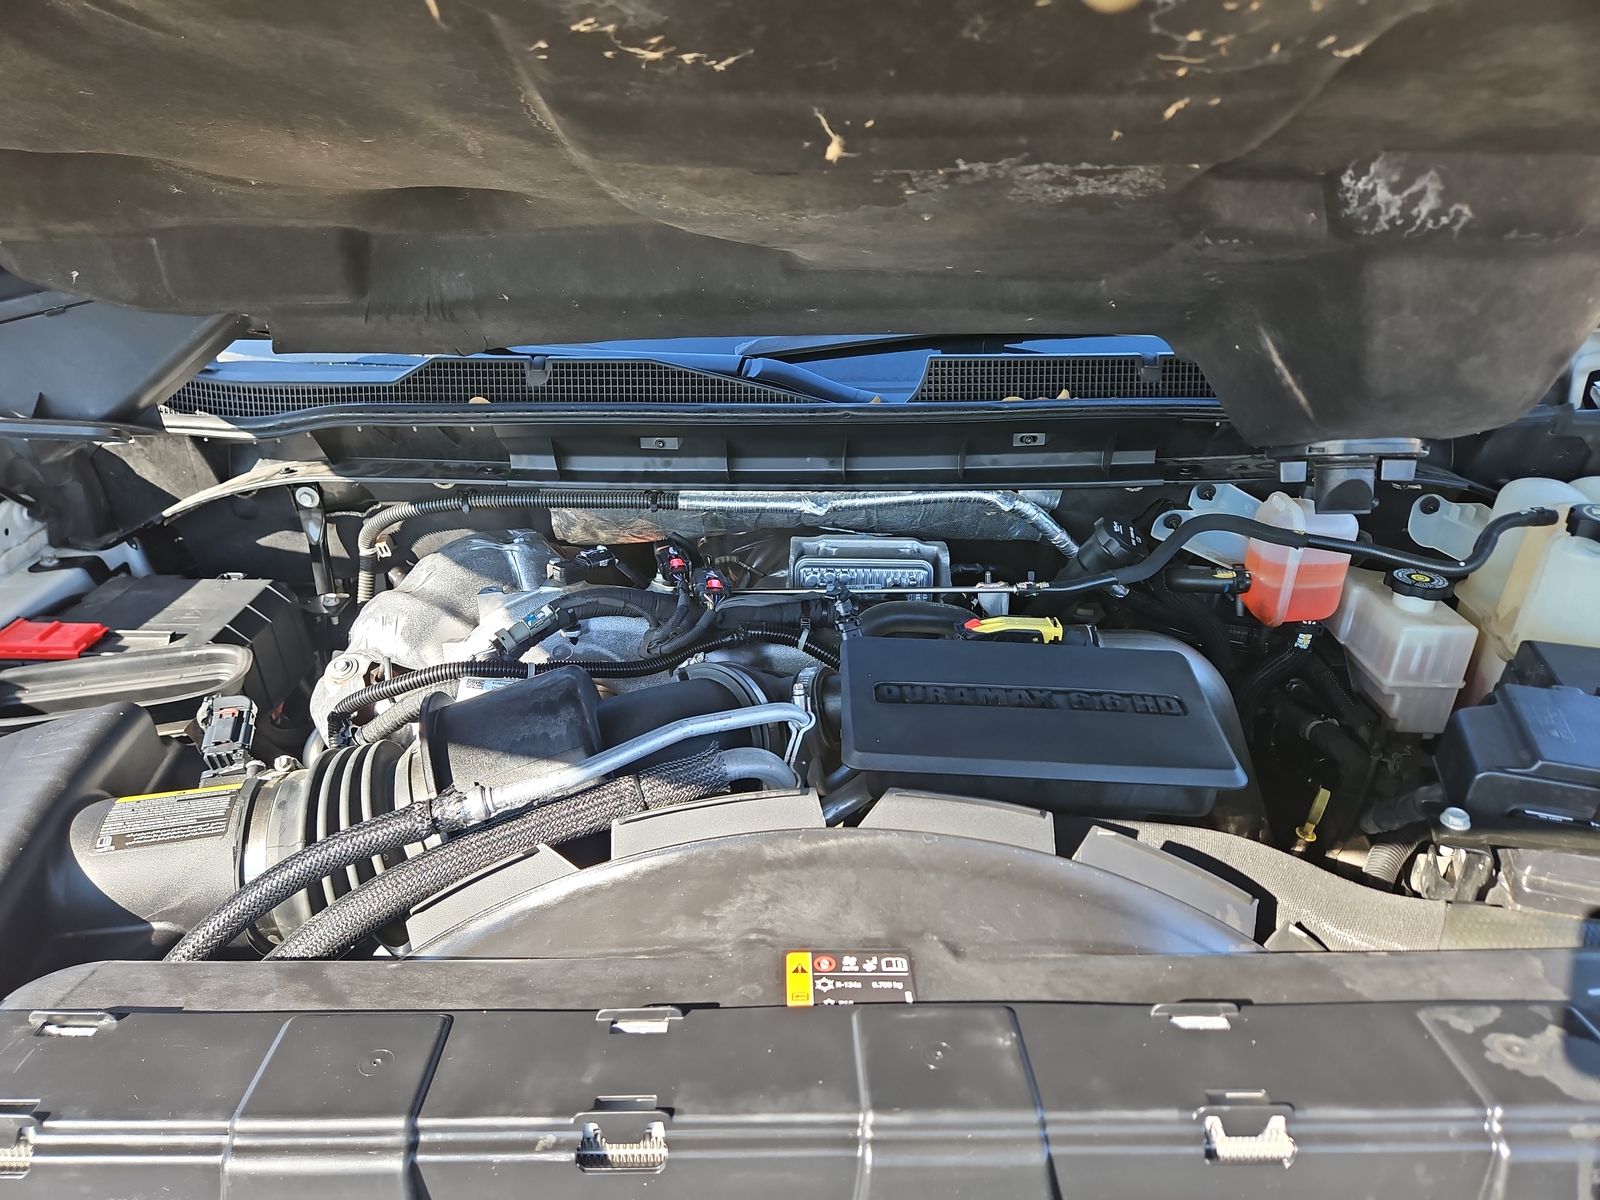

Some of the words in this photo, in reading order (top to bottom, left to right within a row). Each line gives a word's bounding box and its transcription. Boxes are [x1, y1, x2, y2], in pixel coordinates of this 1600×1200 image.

[880, 685, 1057, 708] DURAMAX
[1069, 691, 1128, 711] 6.6
[1133, 694, 1182, 714] HD
